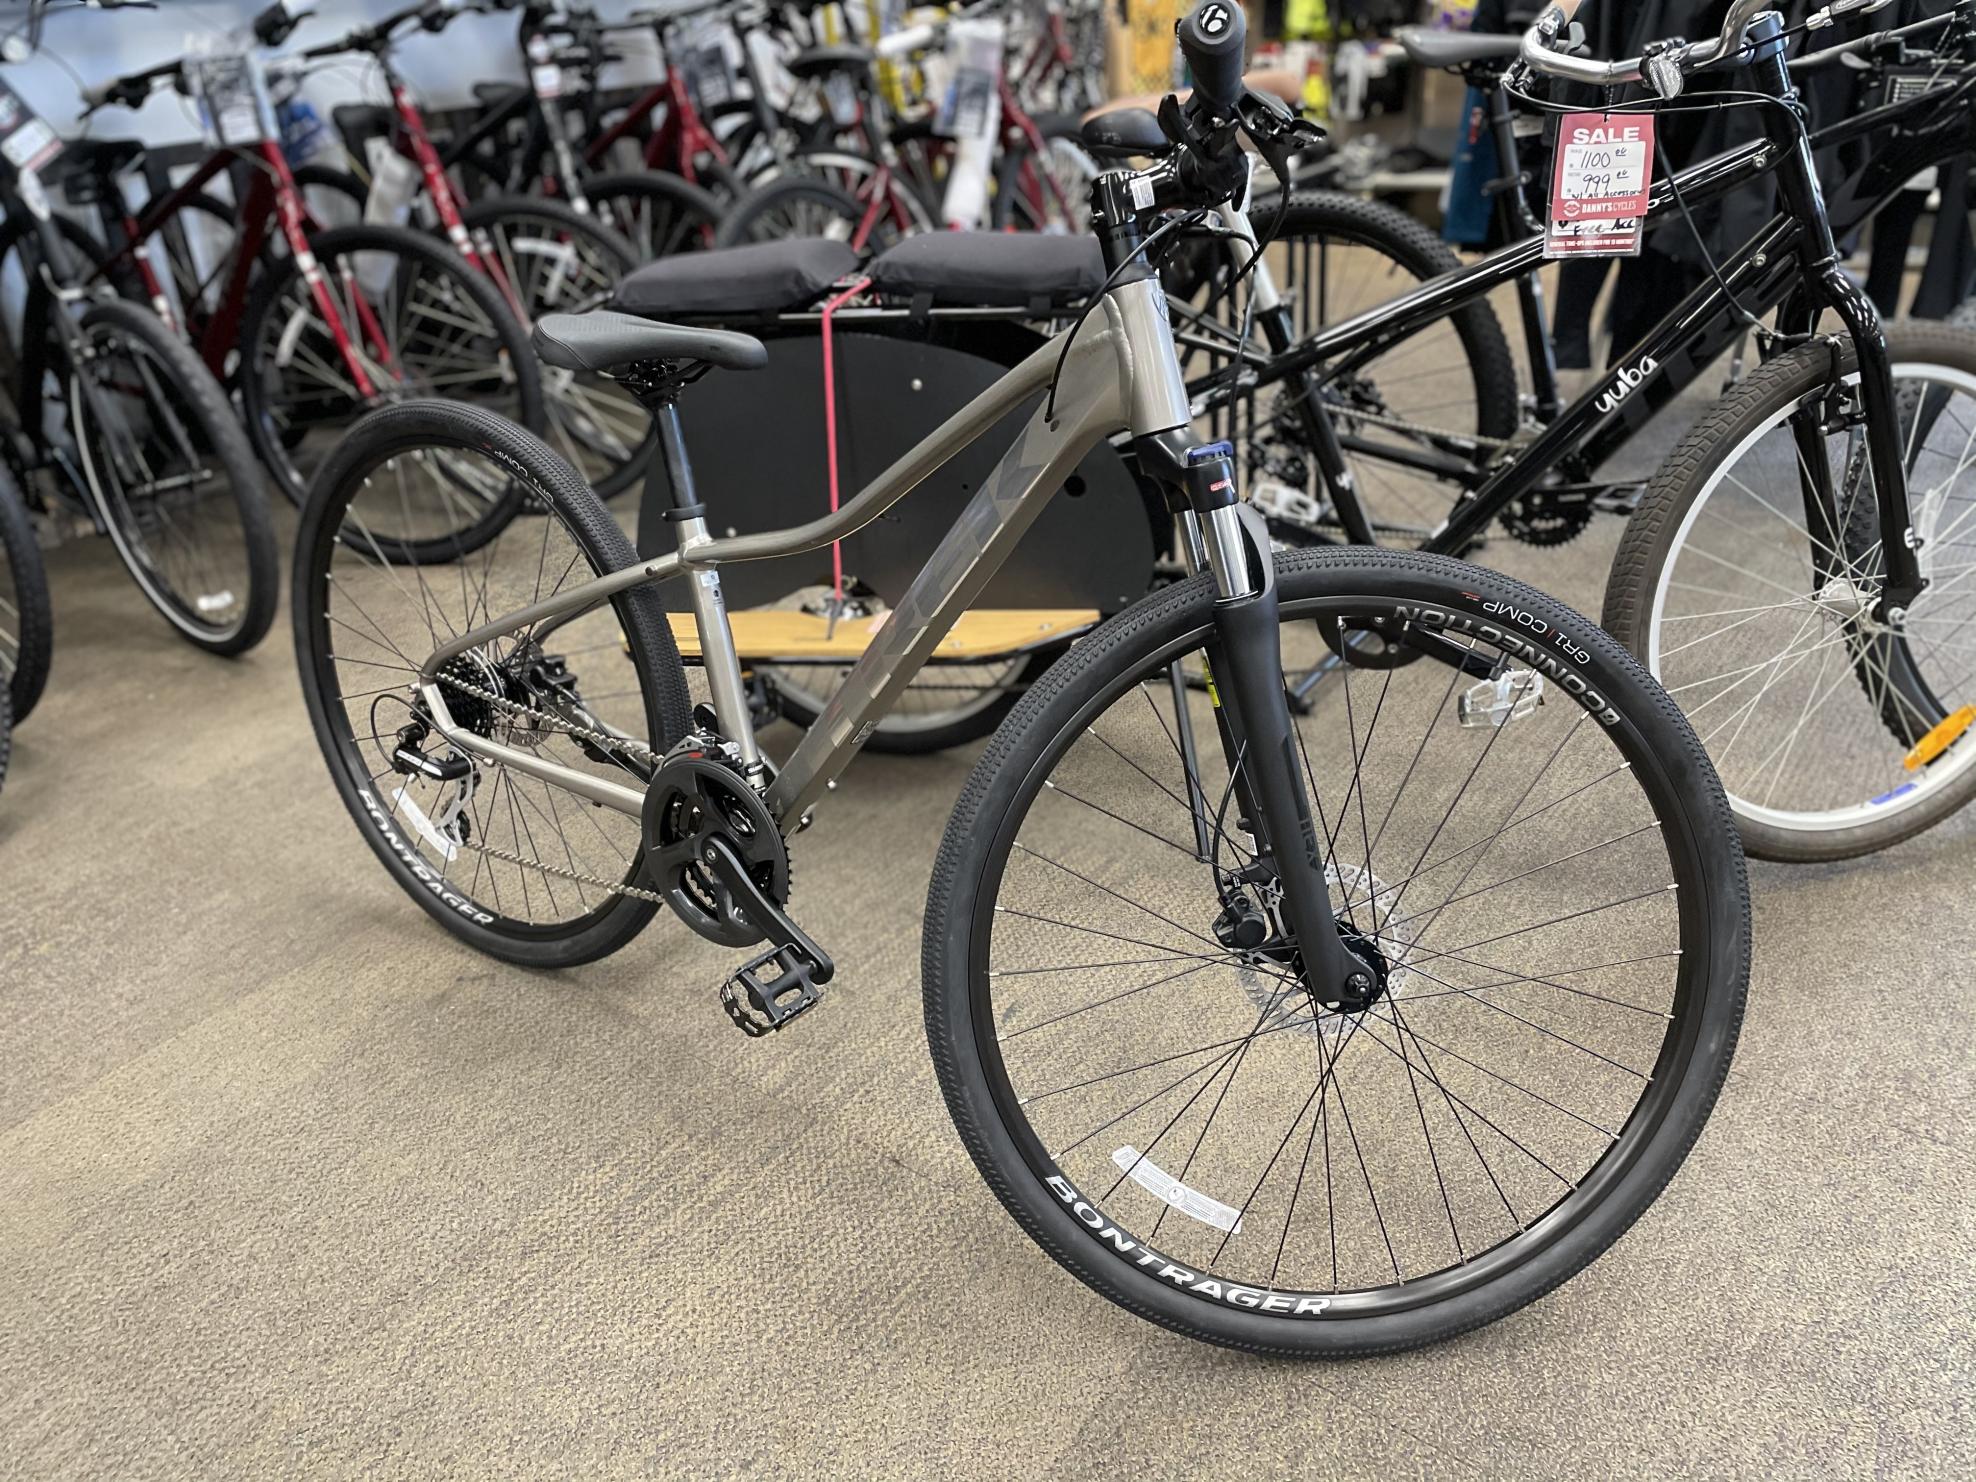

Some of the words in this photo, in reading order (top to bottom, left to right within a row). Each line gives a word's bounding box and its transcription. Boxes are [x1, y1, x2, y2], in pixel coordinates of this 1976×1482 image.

[1573, 127, 1640, 144] SALE
[1581, 151, 1611, 168] 1100
[1583, 174, 1611, 193] 999
[1581, 202, 1613, 214] DANNY'S
[1613, 200, 1637, 211] CYCLES
[1595, 355, 1659, 413] yuba
[1483, 601, 1548, 634] COMP
[1394, 605, 1607, 713] CONNECTION
[1552, 632, 1591, 665] GR1
[358, 789, 494, 925] BONTRAGER
[1045, 1175, 1331, 1315] BONTRAGER
